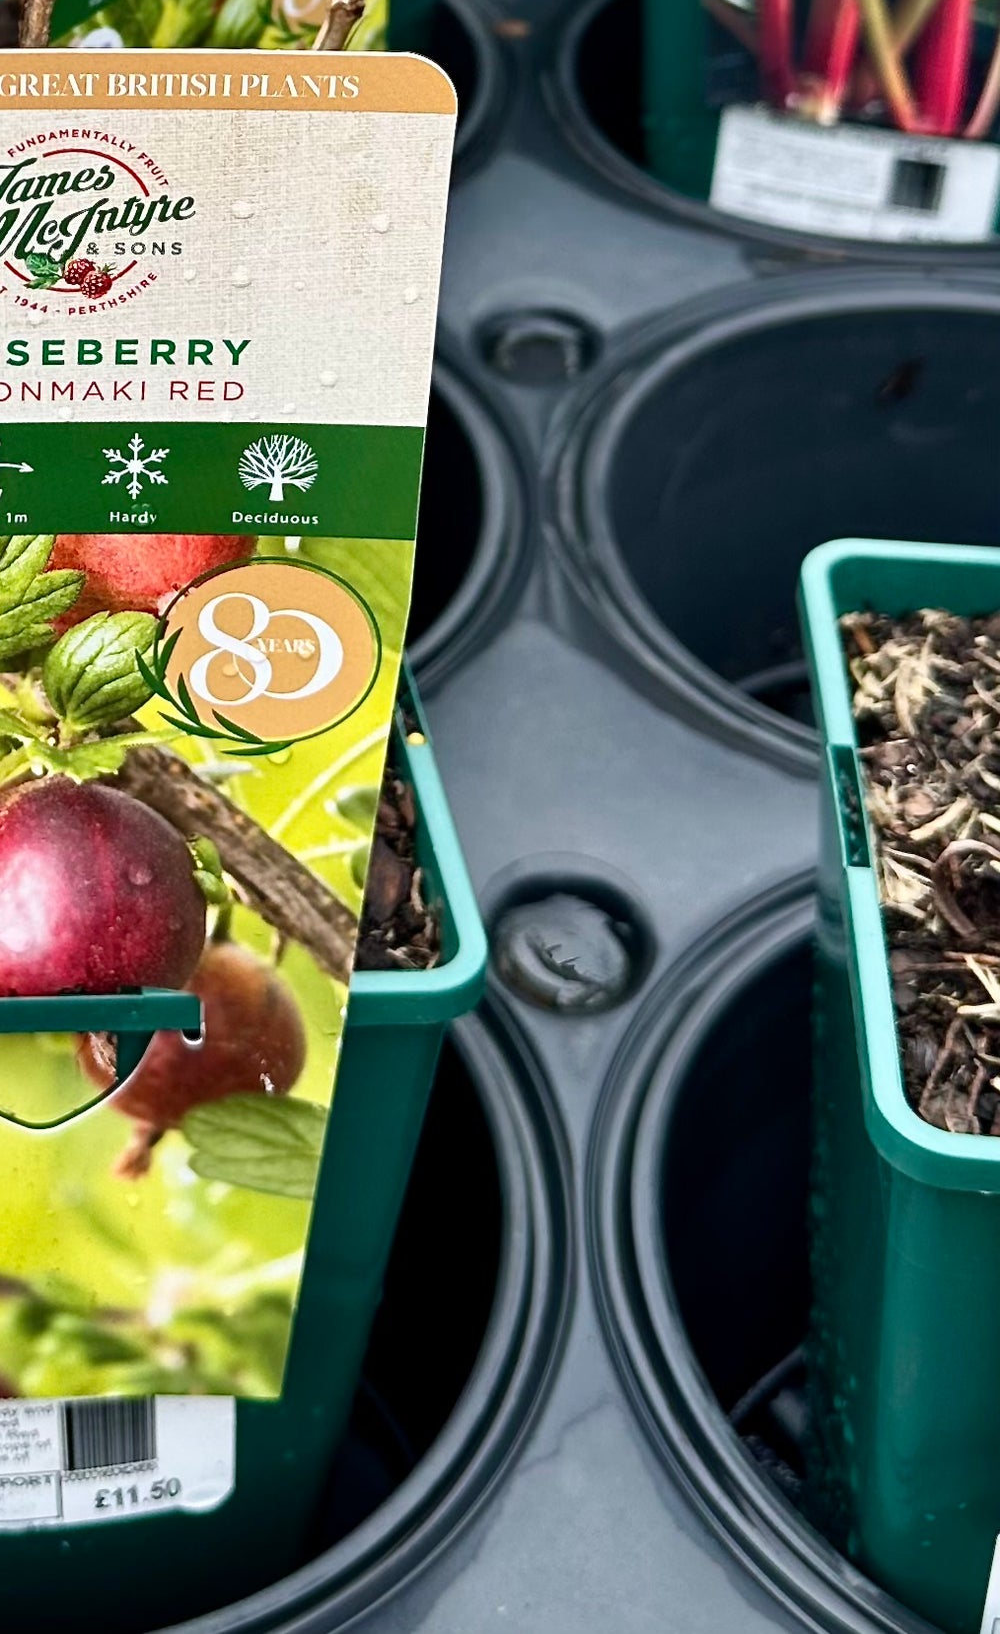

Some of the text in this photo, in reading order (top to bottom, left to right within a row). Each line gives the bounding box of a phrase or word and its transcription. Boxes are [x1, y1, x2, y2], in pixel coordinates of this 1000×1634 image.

[106, 72, 233, 98] BRITISH
[240, 74, 360, 100] PLANTS
[7, 129, 169, 187] FUNDAMENTALLY FRUIT
[86, 242, 183, 256] & SONS
[14, 295, 48, 313] 1944
[68, 272, 158, 316] PERTHSHIRE
[169, 380, 245, 402] RED
[6, 512, 29, 523] 1m
[109, 511, 157, 526] Hardy
[232, 511, 319, 525] Deciduous
[189, 592, 345, 706] 80
[256, 638, 316, 654] YEARS
[94, 1477, 182, 1509] £11.50
